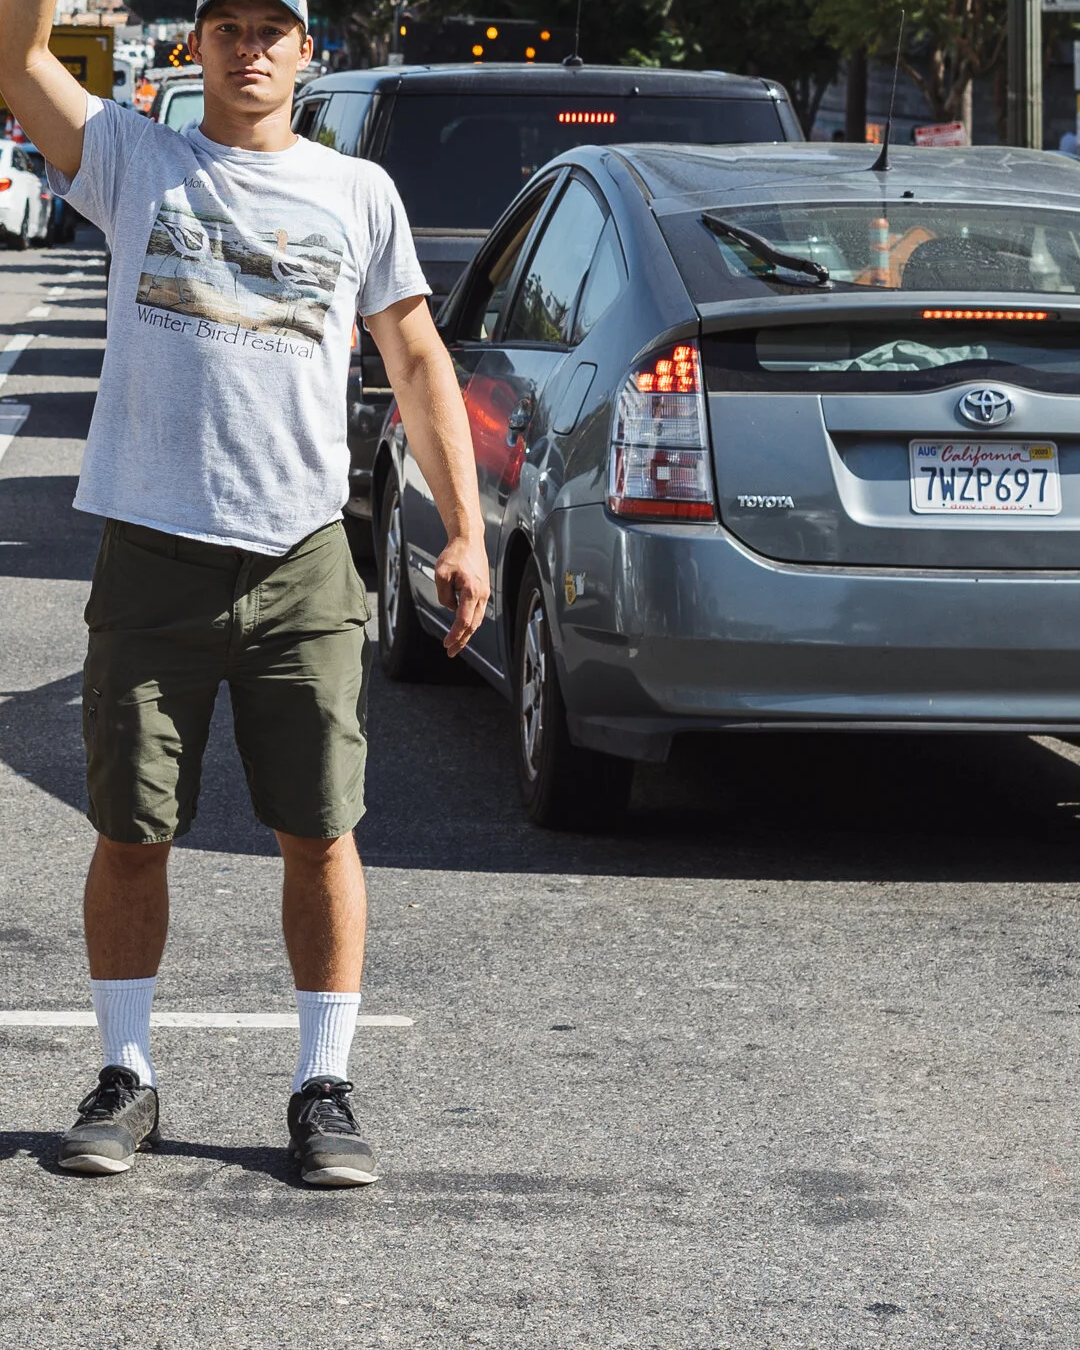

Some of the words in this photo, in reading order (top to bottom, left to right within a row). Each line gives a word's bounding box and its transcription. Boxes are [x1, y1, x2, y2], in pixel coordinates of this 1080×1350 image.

[136, 305, 192, 333] Winter
[195, 319, 241, 345] Bird
[242, 330, 316, 360] Festival
[917, 446, 937, 457] AUG
[941, 444, 1032, 468] California
[920, 466, 1048, 503] 7WZP697
[736, 495, 795, 508] TOYOTA
